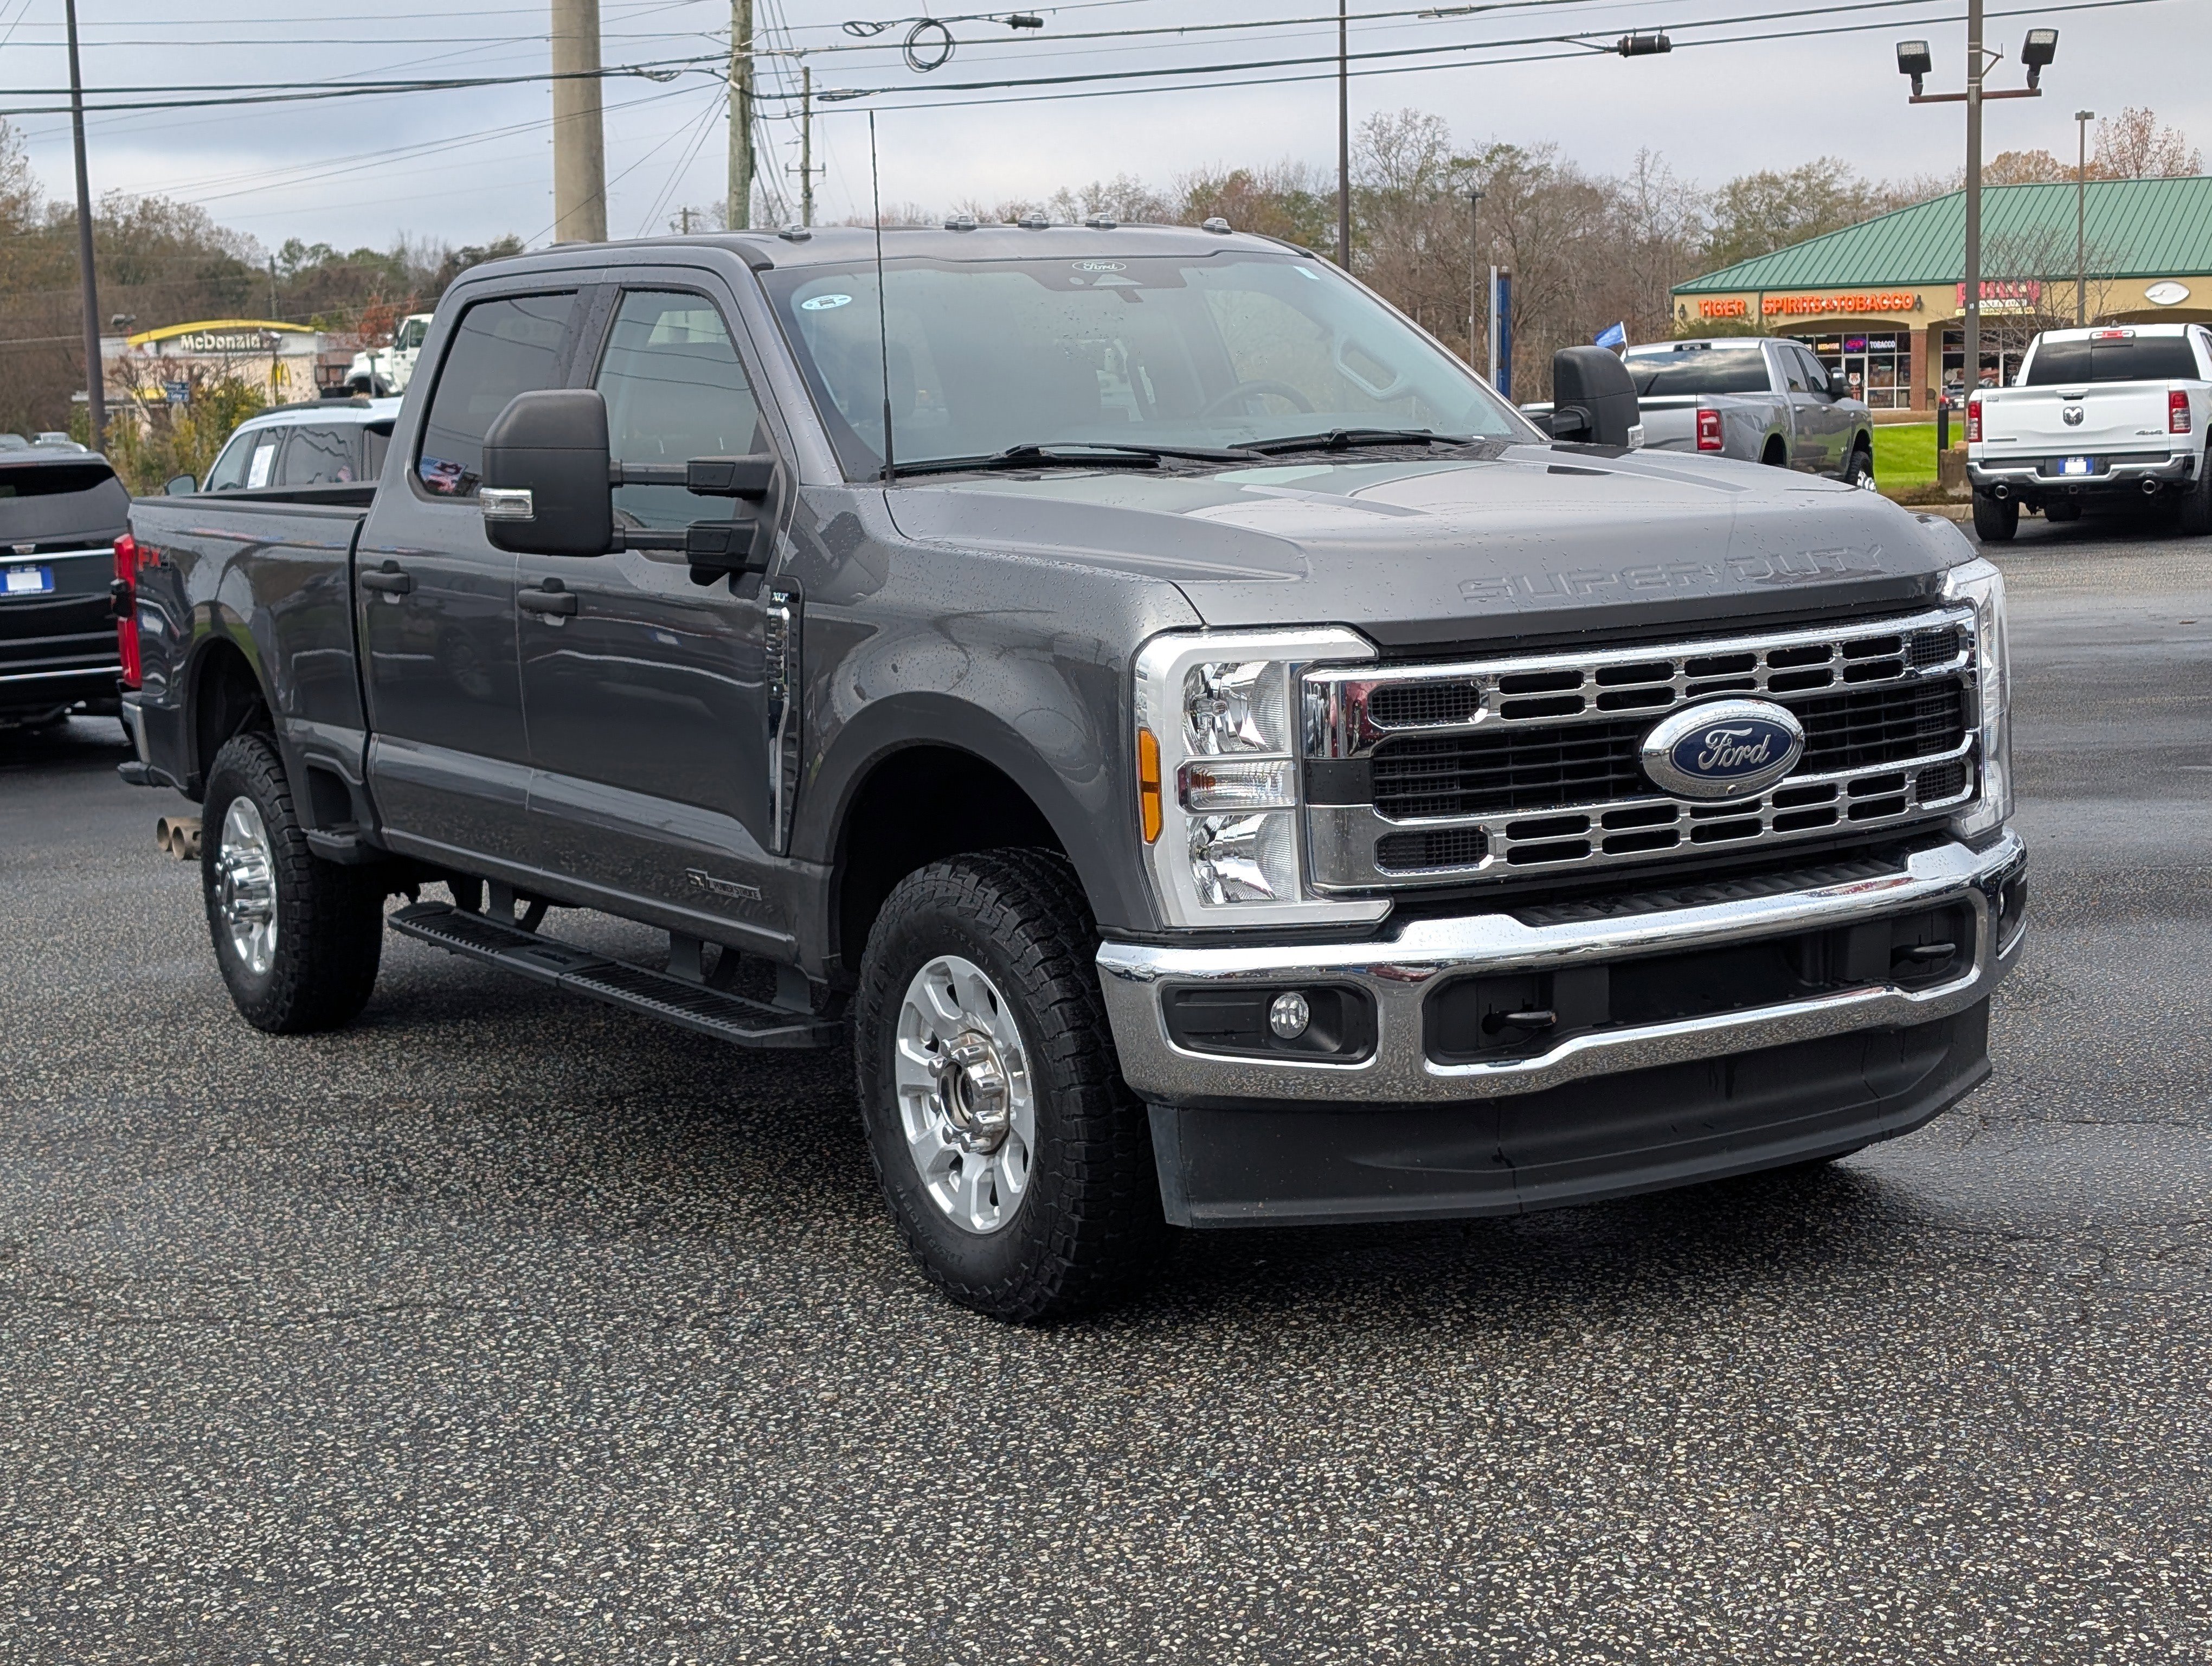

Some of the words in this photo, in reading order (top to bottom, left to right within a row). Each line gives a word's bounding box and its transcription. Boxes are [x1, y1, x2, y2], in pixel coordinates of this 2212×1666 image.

[1083, 261, 1117, 270] Ford
[1698, 299, 1745, 316] TIGER
[1762, 296, 1823, 315] SPIRITS
[1835, 292, 1914, 312] TOBACCO
[1870, 340, 1895, 349] TOBACCO
[1457, 561, 1720, 603] SUPER
[1726, 543, 1883, 584] DUTY
[1698, 727, 1771, 770] Ford
